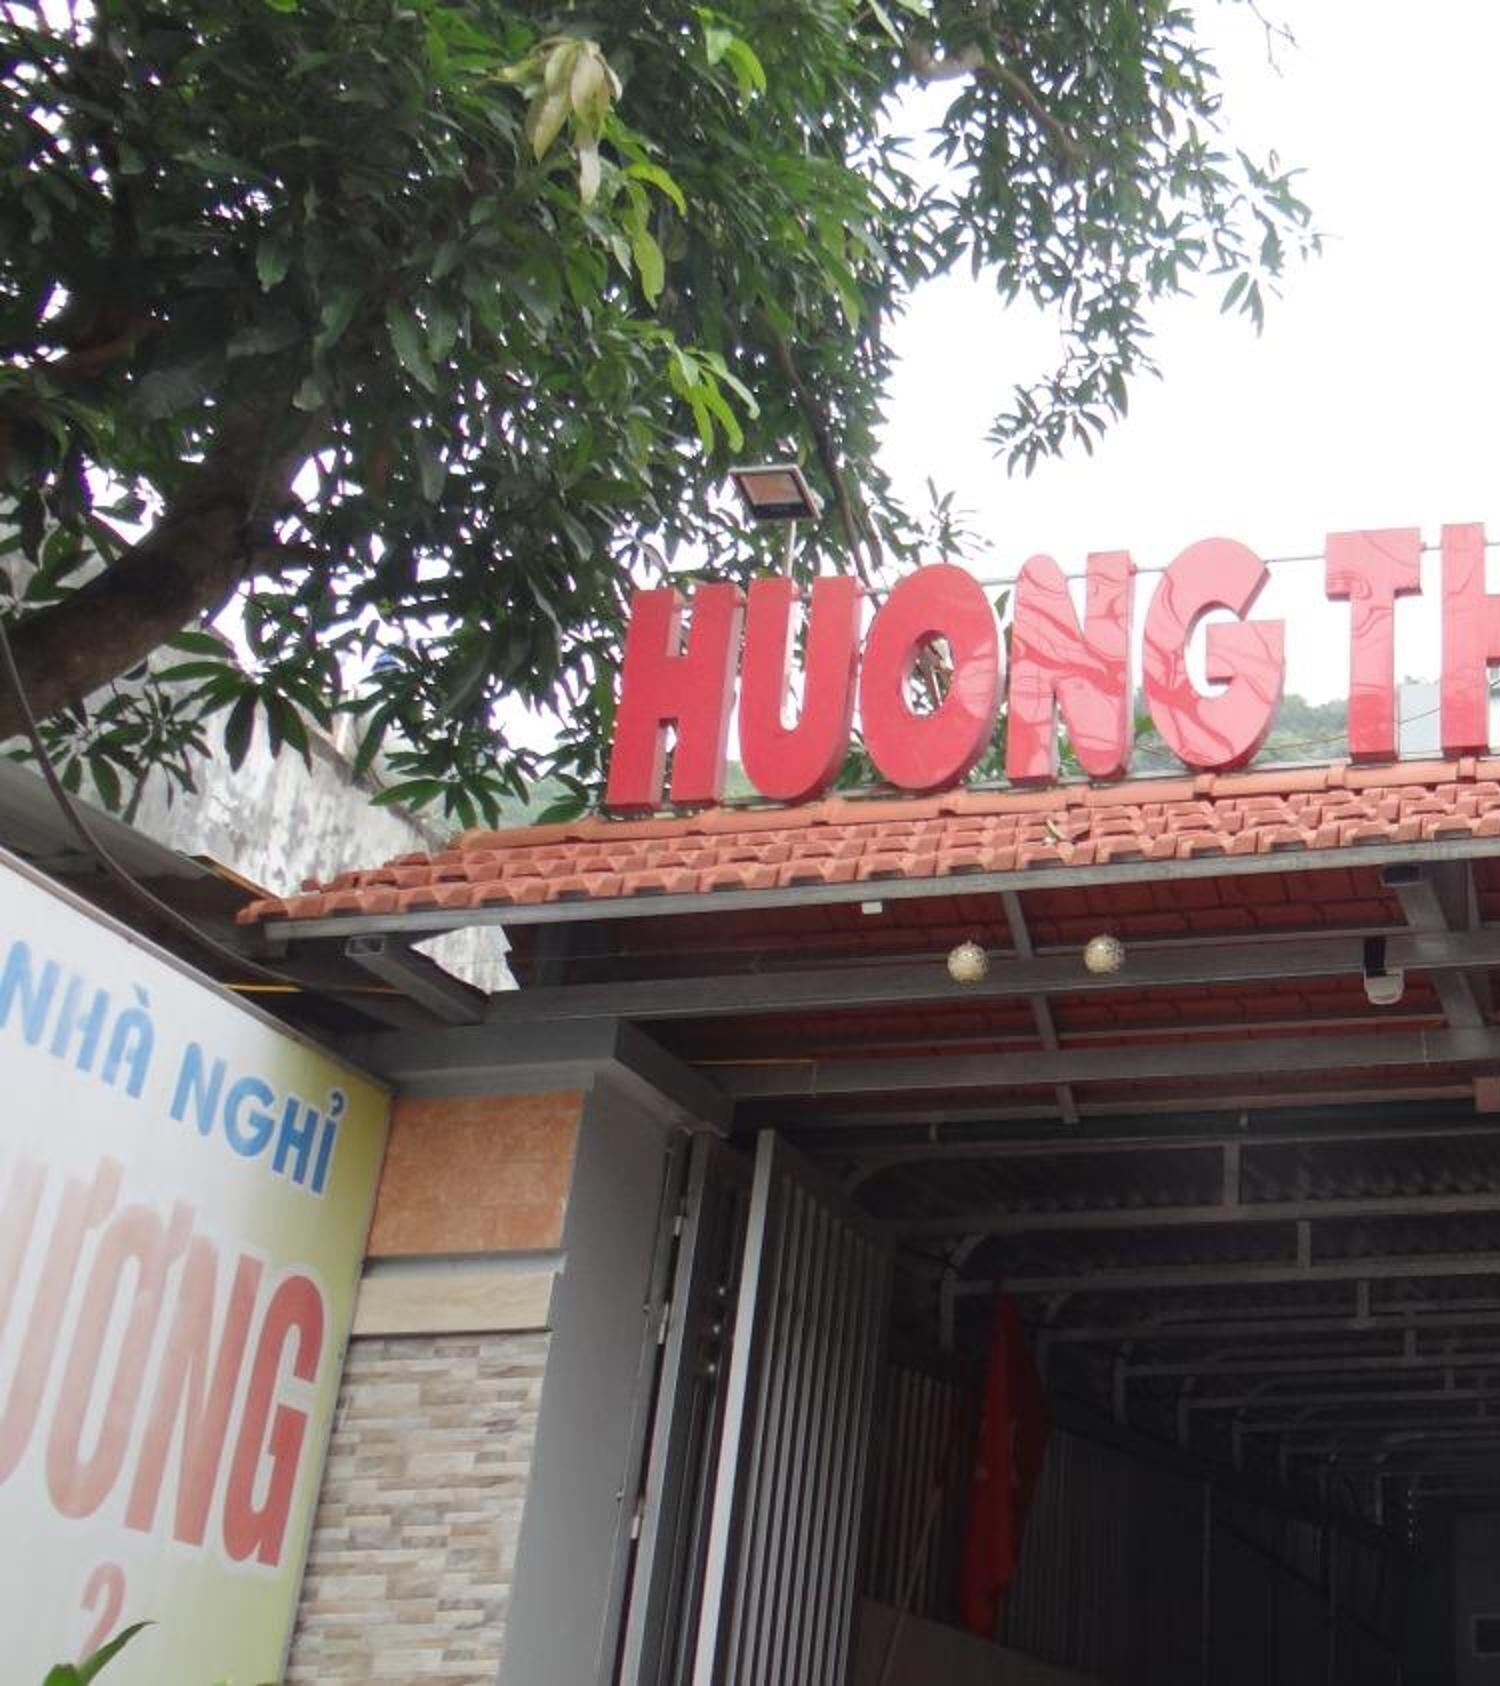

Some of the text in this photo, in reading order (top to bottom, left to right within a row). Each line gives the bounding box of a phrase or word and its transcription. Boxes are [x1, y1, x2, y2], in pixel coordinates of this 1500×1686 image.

[606, 537, 1286, 813] HUONG
[0, 940, 345, 1195] NHÀ NGHỈ
